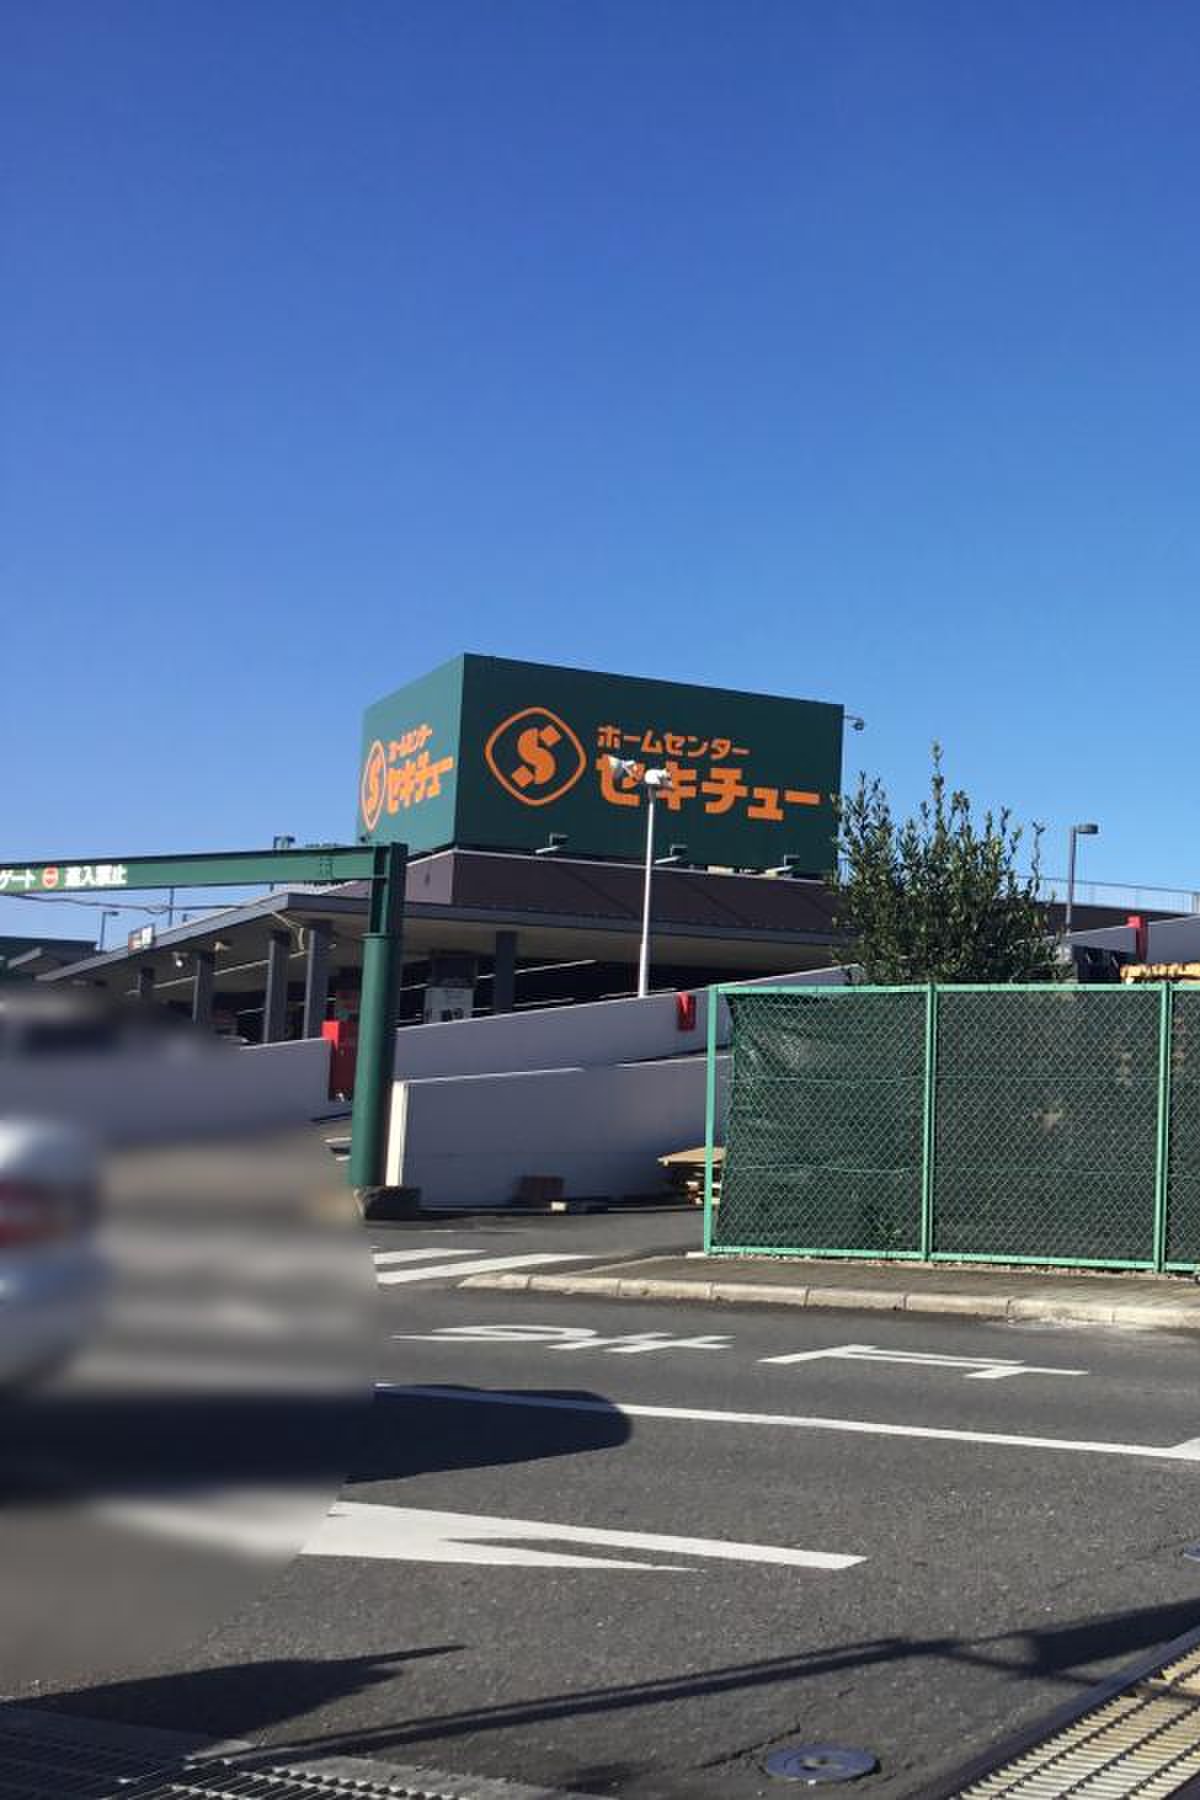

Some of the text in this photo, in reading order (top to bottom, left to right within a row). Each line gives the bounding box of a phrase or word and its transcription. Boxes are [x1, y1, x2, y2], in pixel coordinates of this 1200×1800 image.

[597, 725, 750, 759] ホームセンター
[597, 755, 820, 821] セキチュー
